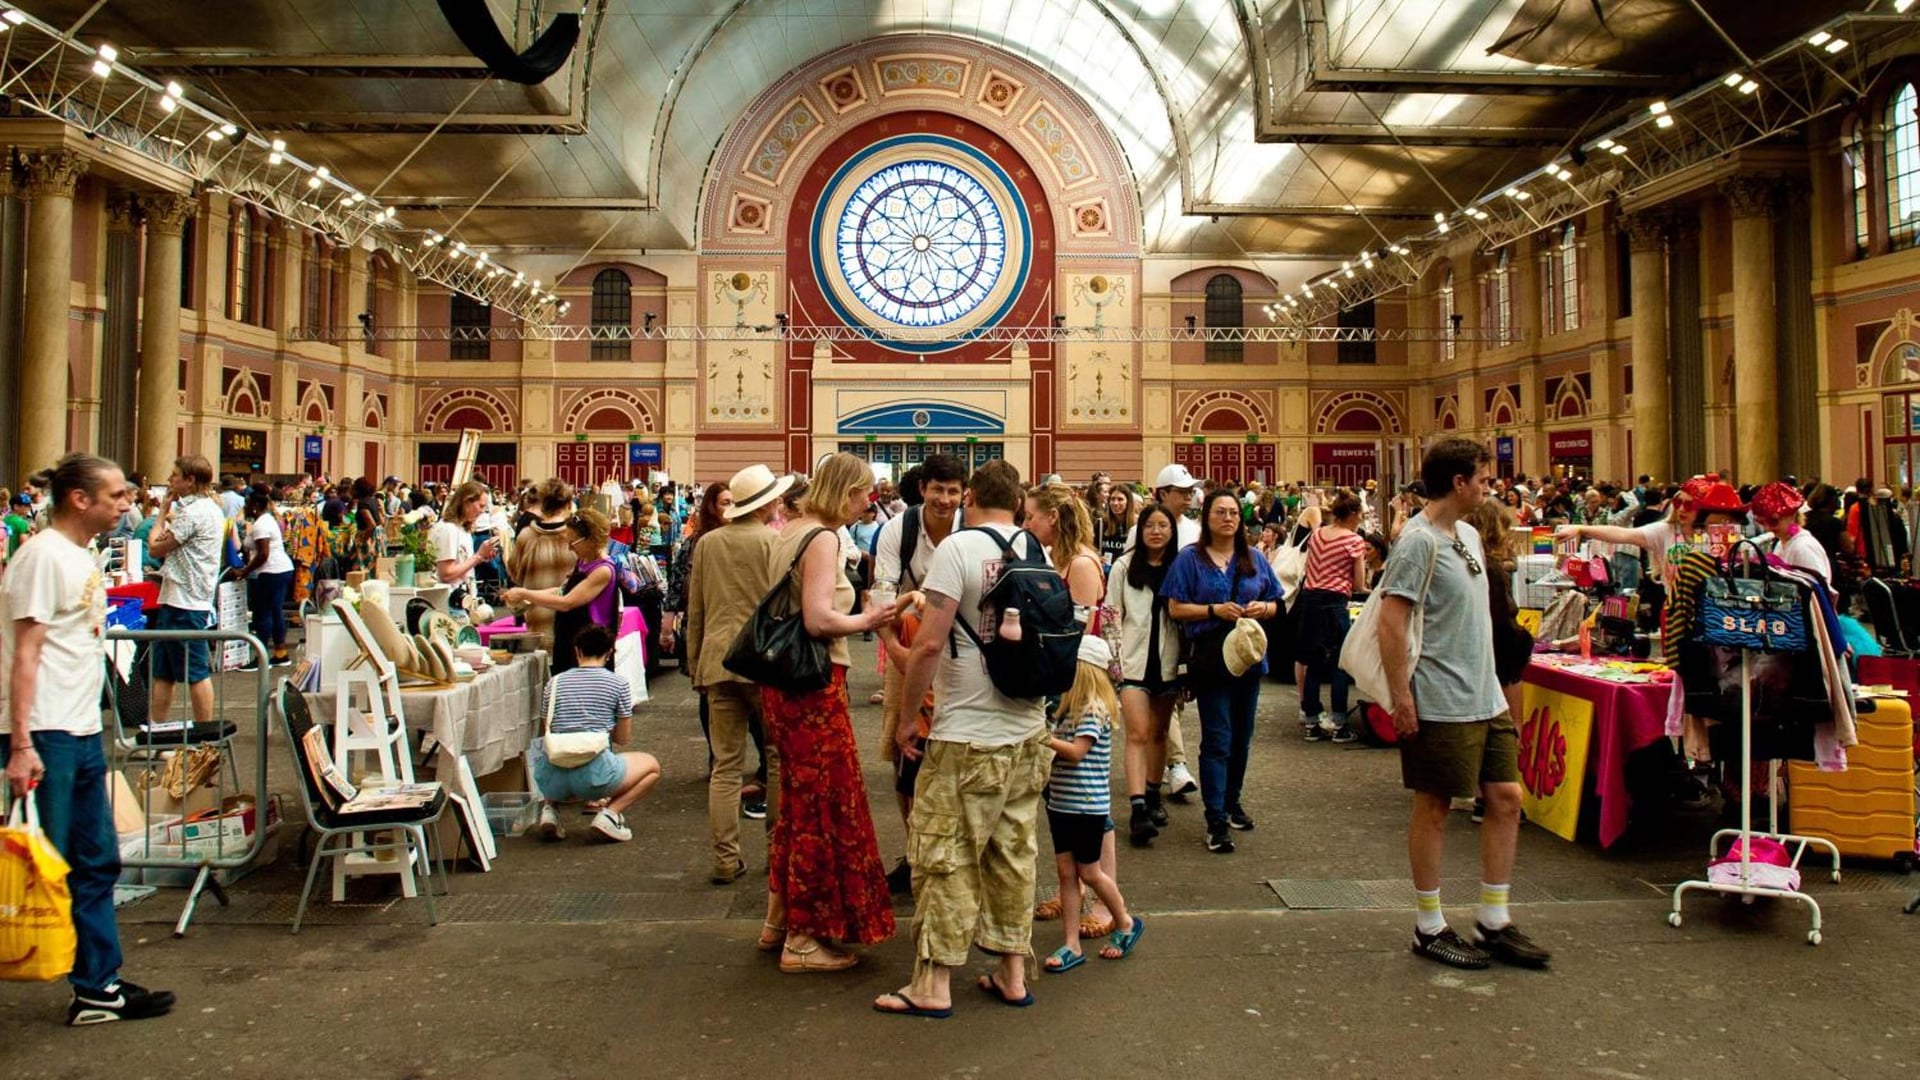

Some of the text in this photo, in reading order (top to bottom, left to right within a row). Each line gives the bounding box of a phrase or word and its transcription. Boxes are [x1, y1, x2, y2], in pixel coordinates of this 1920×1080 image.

[233, 434, 252, 451] BAR
[1332, 449, 1368, 457] BREWER'S
[1723, 616, 1786, 635] SLAG
